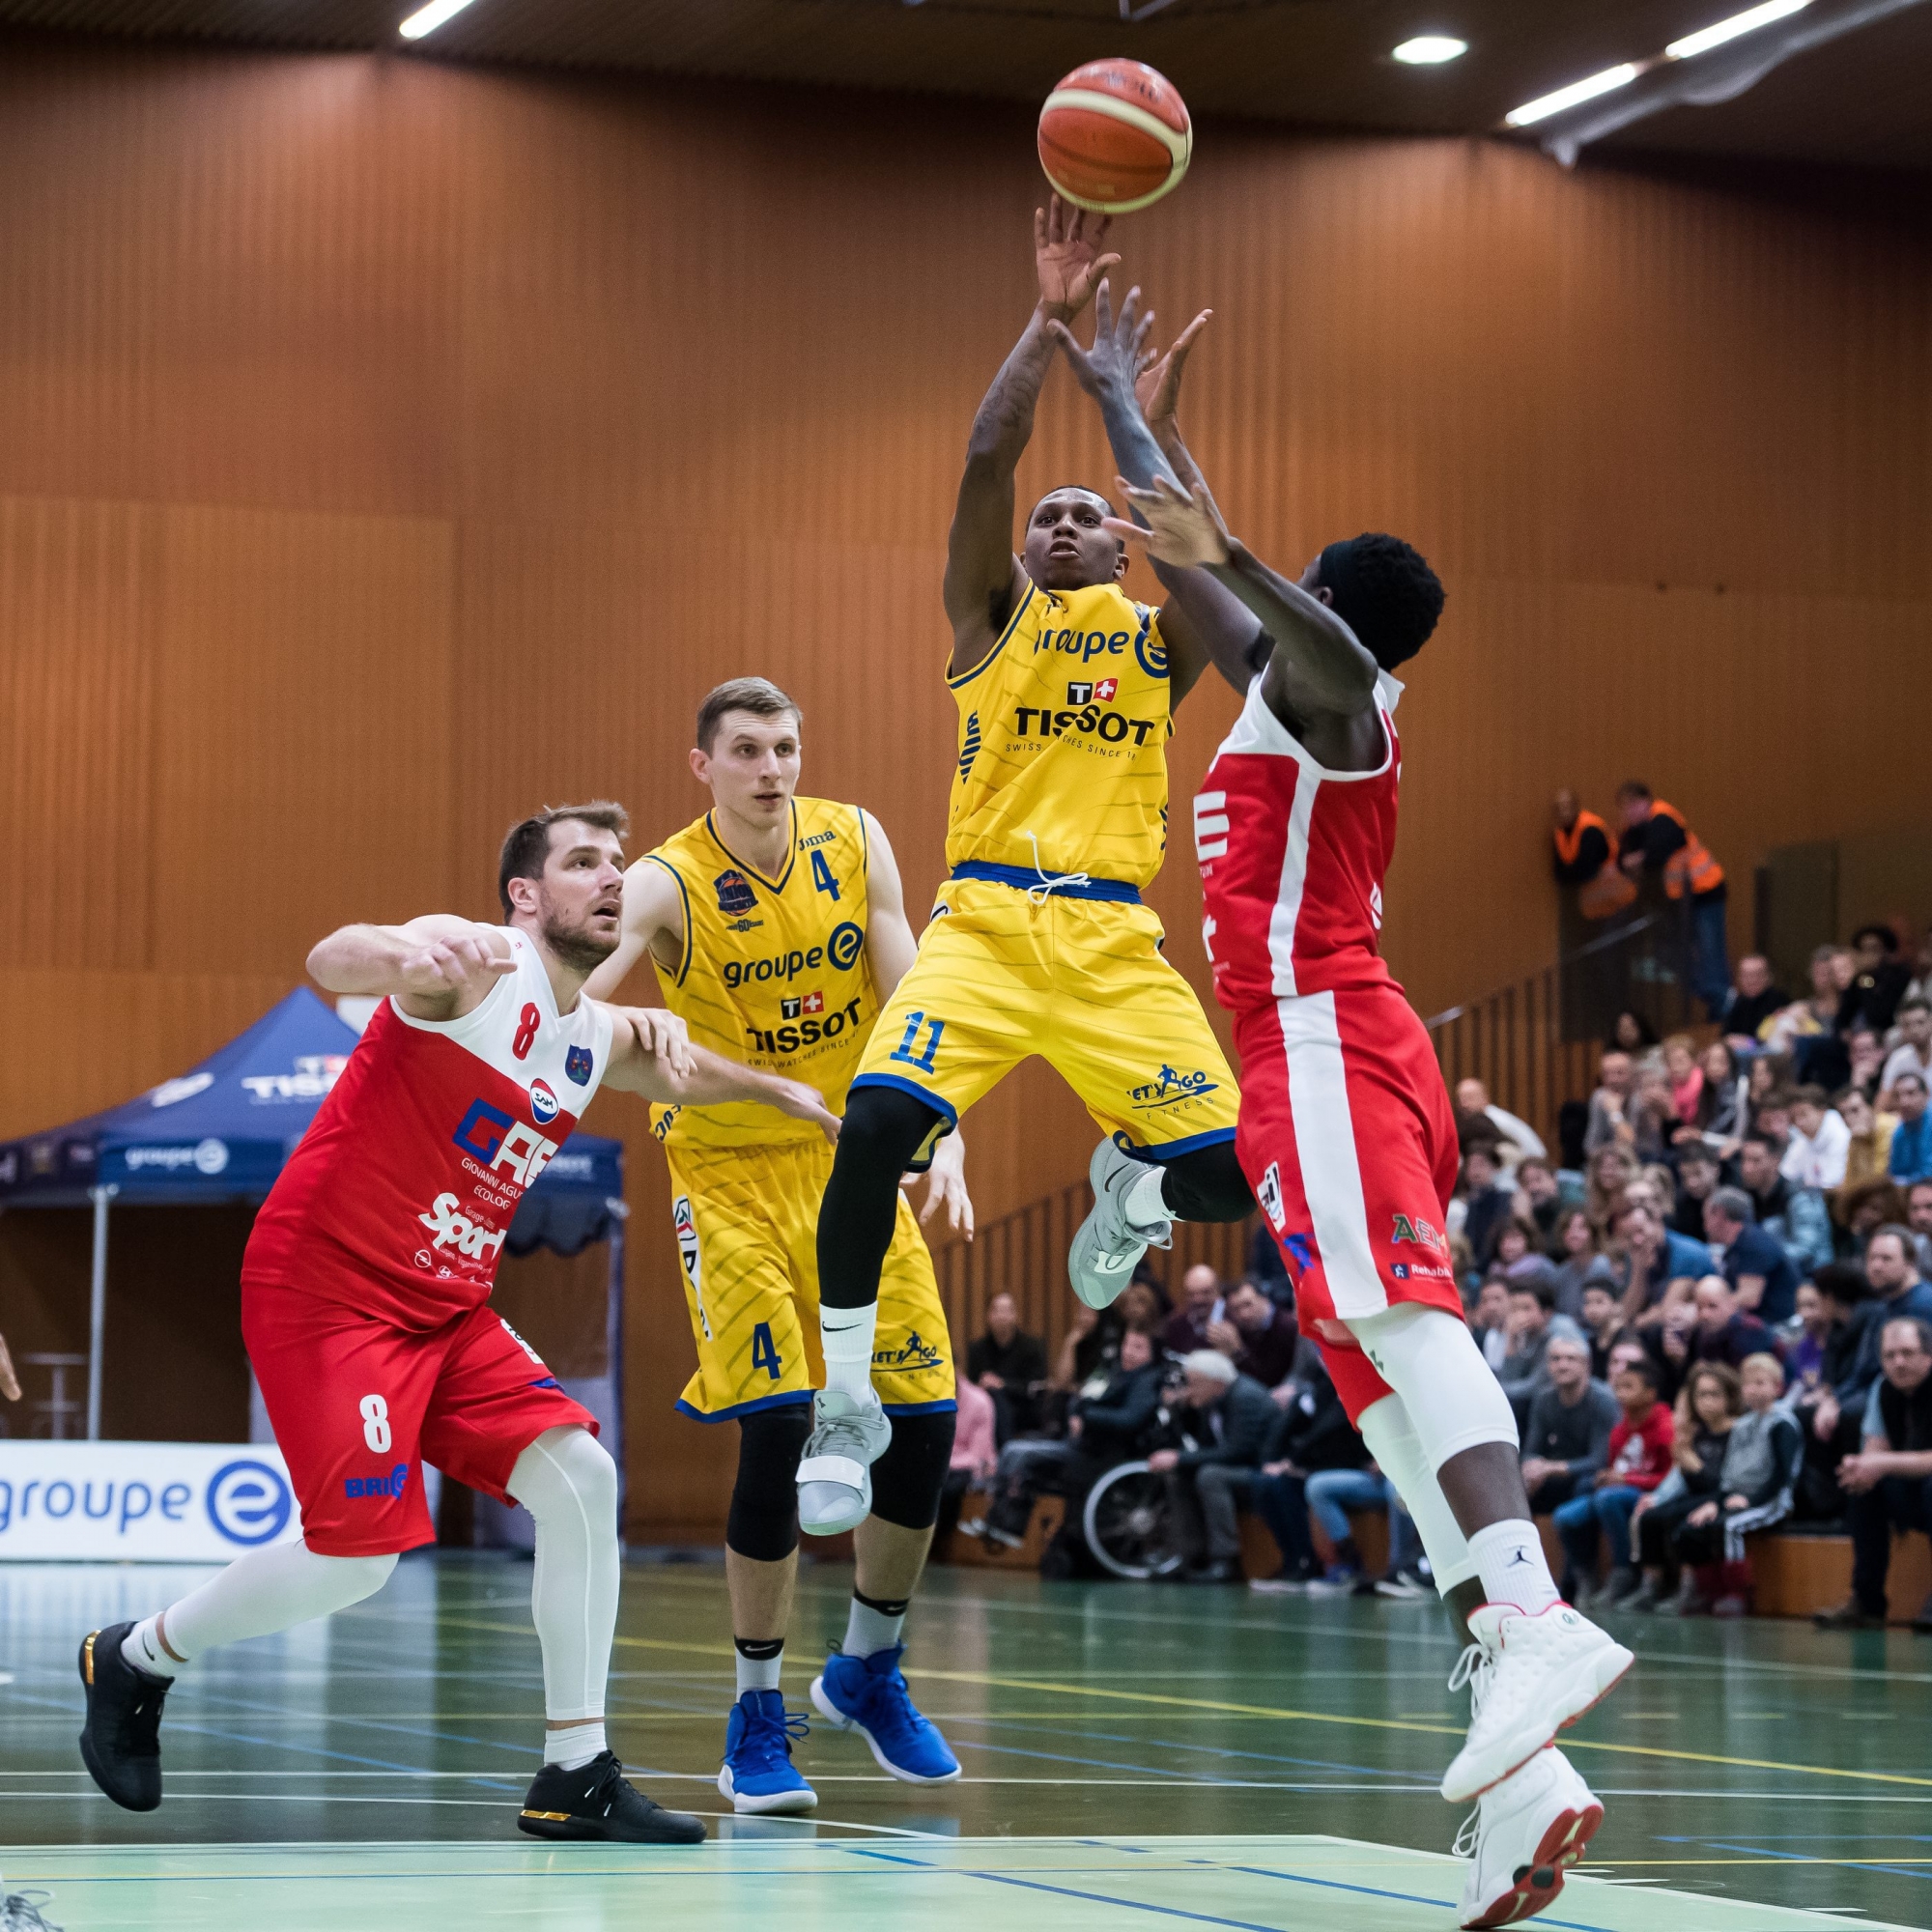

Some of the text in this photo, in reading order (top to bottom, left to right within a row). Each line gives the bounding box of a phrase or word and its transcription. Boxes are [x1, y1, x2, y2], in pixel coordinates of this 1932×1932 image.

[1014, 704, 1155, 747] TISSOT
[1005, 743, 1042, 753] SWISS
[1087, 744, 1122, 757] SINCE
[810, 848, 841, 902] 4
[724, 946, 823, 988] groupe
[512, 1002, 541, 1061] 8
[746, 997, 862, 1054] TISSOT
[889, 1010, 946, 1075] 11
[1181, 1070, 1208, 1089] GO
[1147, 1096, 1214, 1121] FTNESS
[461, 1156, 500, 1189] GIOVANNI
[752, 1321, 783, 1380] 4
[358, 1393, 392, 1454] 8
